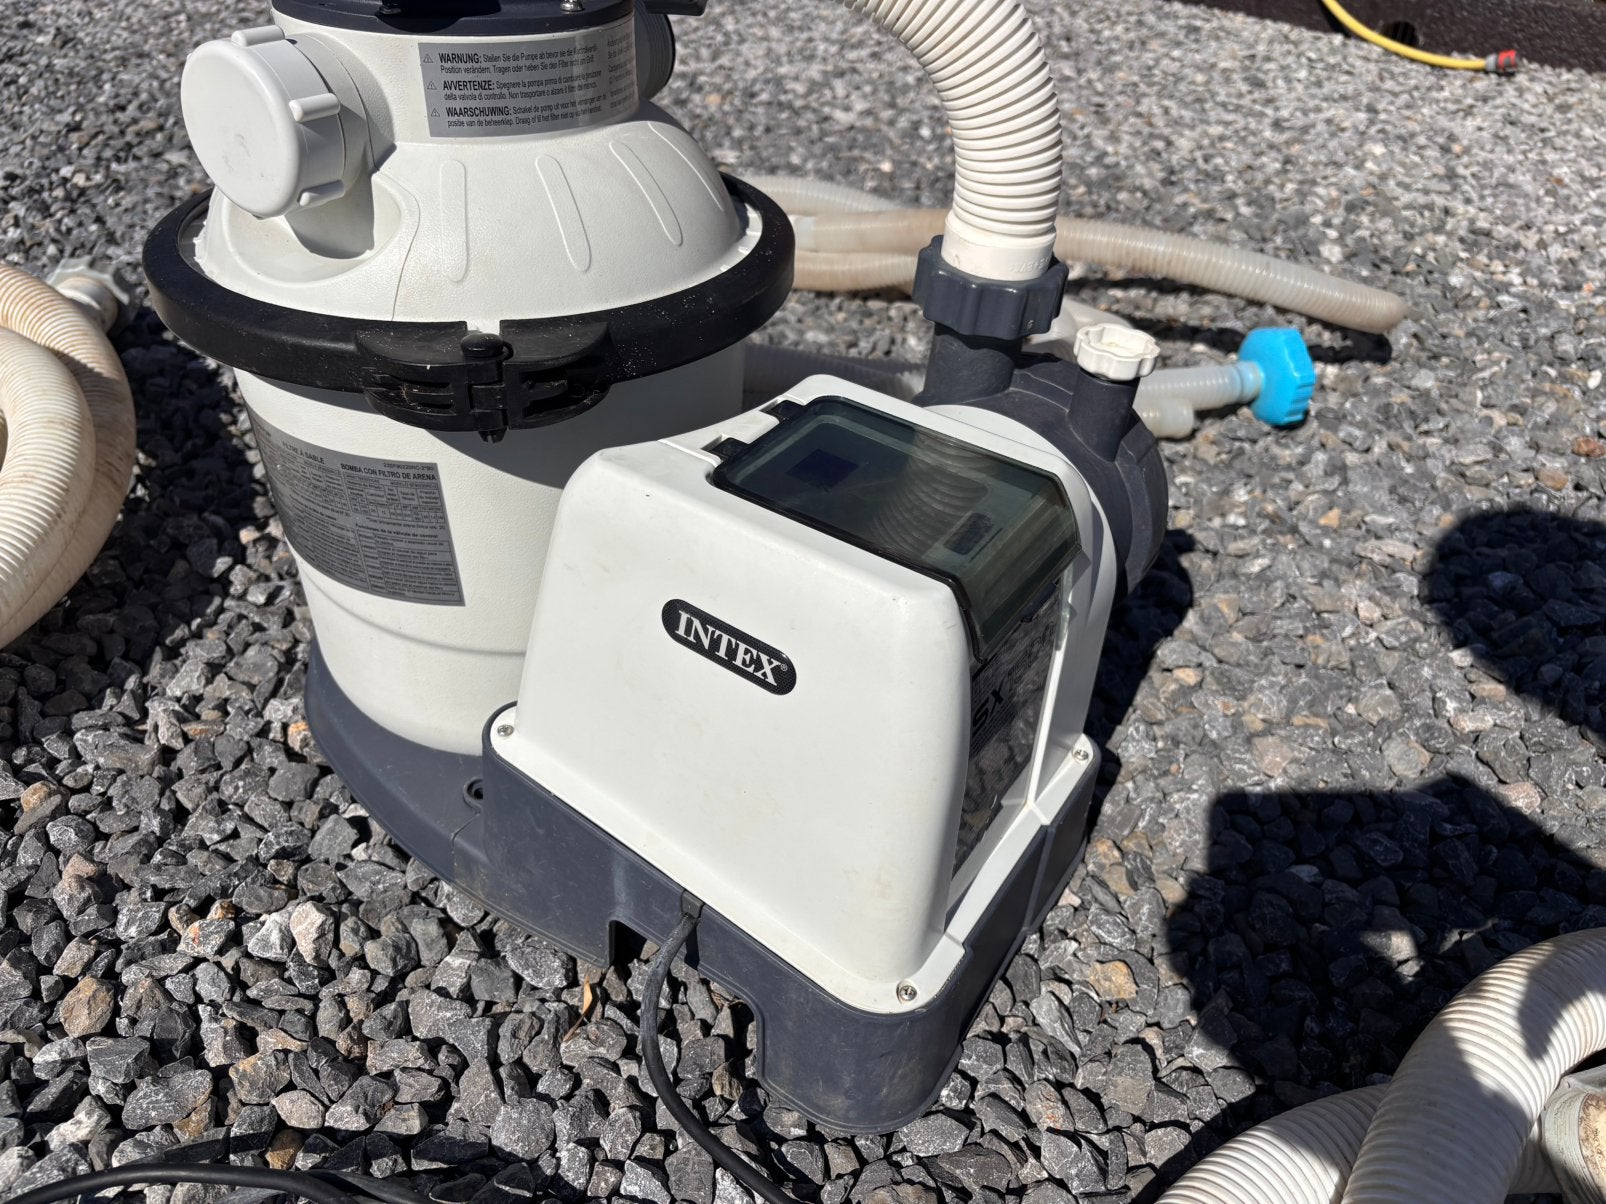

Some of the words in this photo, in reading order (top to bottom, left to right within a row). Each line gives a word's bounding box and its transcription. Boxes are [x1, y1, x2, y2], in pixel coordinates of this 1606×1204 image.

[439, 53, 482, 64] WARNUNG:
[502, 53, 511, 62] Sie
[521, 52, 538, 62] Pumpe
[441, 65, 462, 74] Position
[492, 64, 511, 75] Tragen
[512, 63, 523, 73] oder
[540, 62, 548, 71] Sie
[443, 80, 495, 91] AVVERTENZE:
[521, 79, 527, 88] la
[527, 80, 543, 89] pompa
[444, 91, 457, 101] della
[509, 90, 519, 100] Non
[446, 105, 512, 118] WAARSCHUWING:
[512, 104, 532, 115] Schakel
[540, 103, 553, 114] pomp
[560, 102, 569, 110] voor
[448, 117, 465, 128] positie
[466, 118, 475, 127] van
[476, 117, 484, 127] de
[515, 116, 530, 126] Draag
[305, 450, 325, 465] SABLE
[341, 463, 363, 474] BOMBA
[363, 467, 377, 476] CON
[379, 469, 401, 479] FILTRO
[402, 472, 411, 480] DE
[412, 473, 437, 481] ARENA
[675, 610, 782, 686] INTEX
